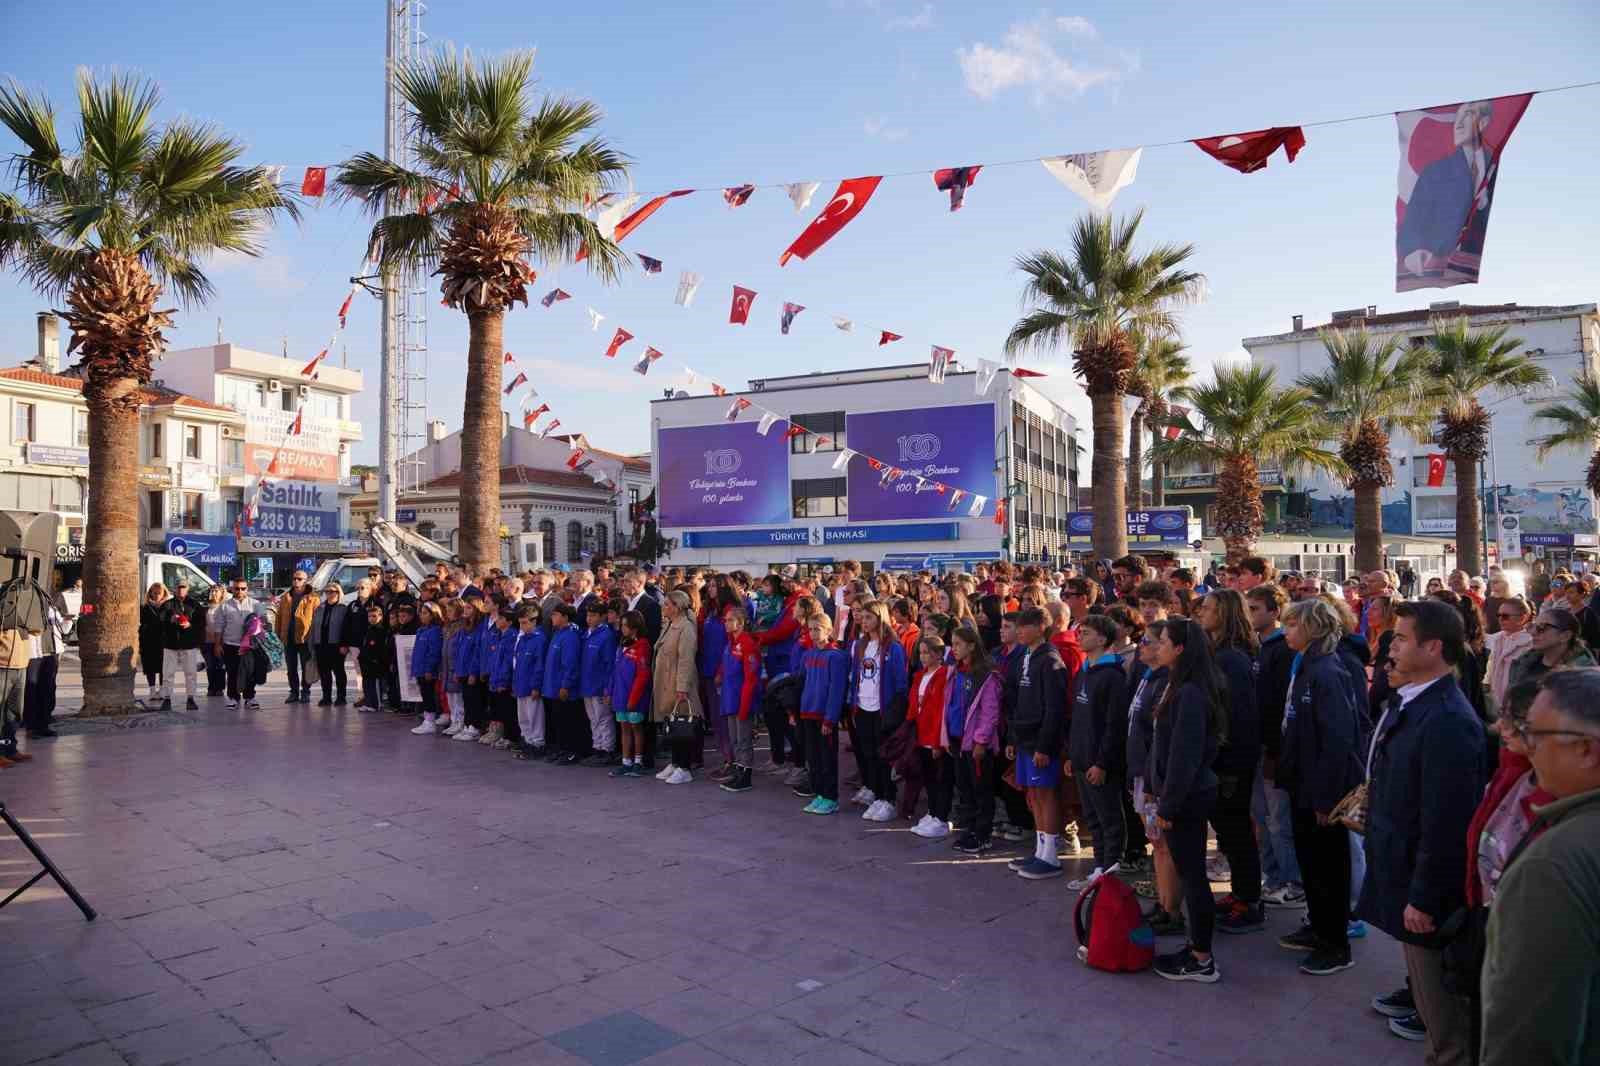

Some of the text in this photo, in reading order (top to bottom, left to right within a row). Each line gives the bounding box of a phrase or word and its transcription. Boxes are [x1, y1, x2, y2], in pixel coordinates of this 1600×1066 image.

[261, 482, 322, 508] Satılık
[260, 512, 321, 533] 235 0 235
[825, 530, 866, 539] BANKASI
[56, 545, 87, 556] ORIS
